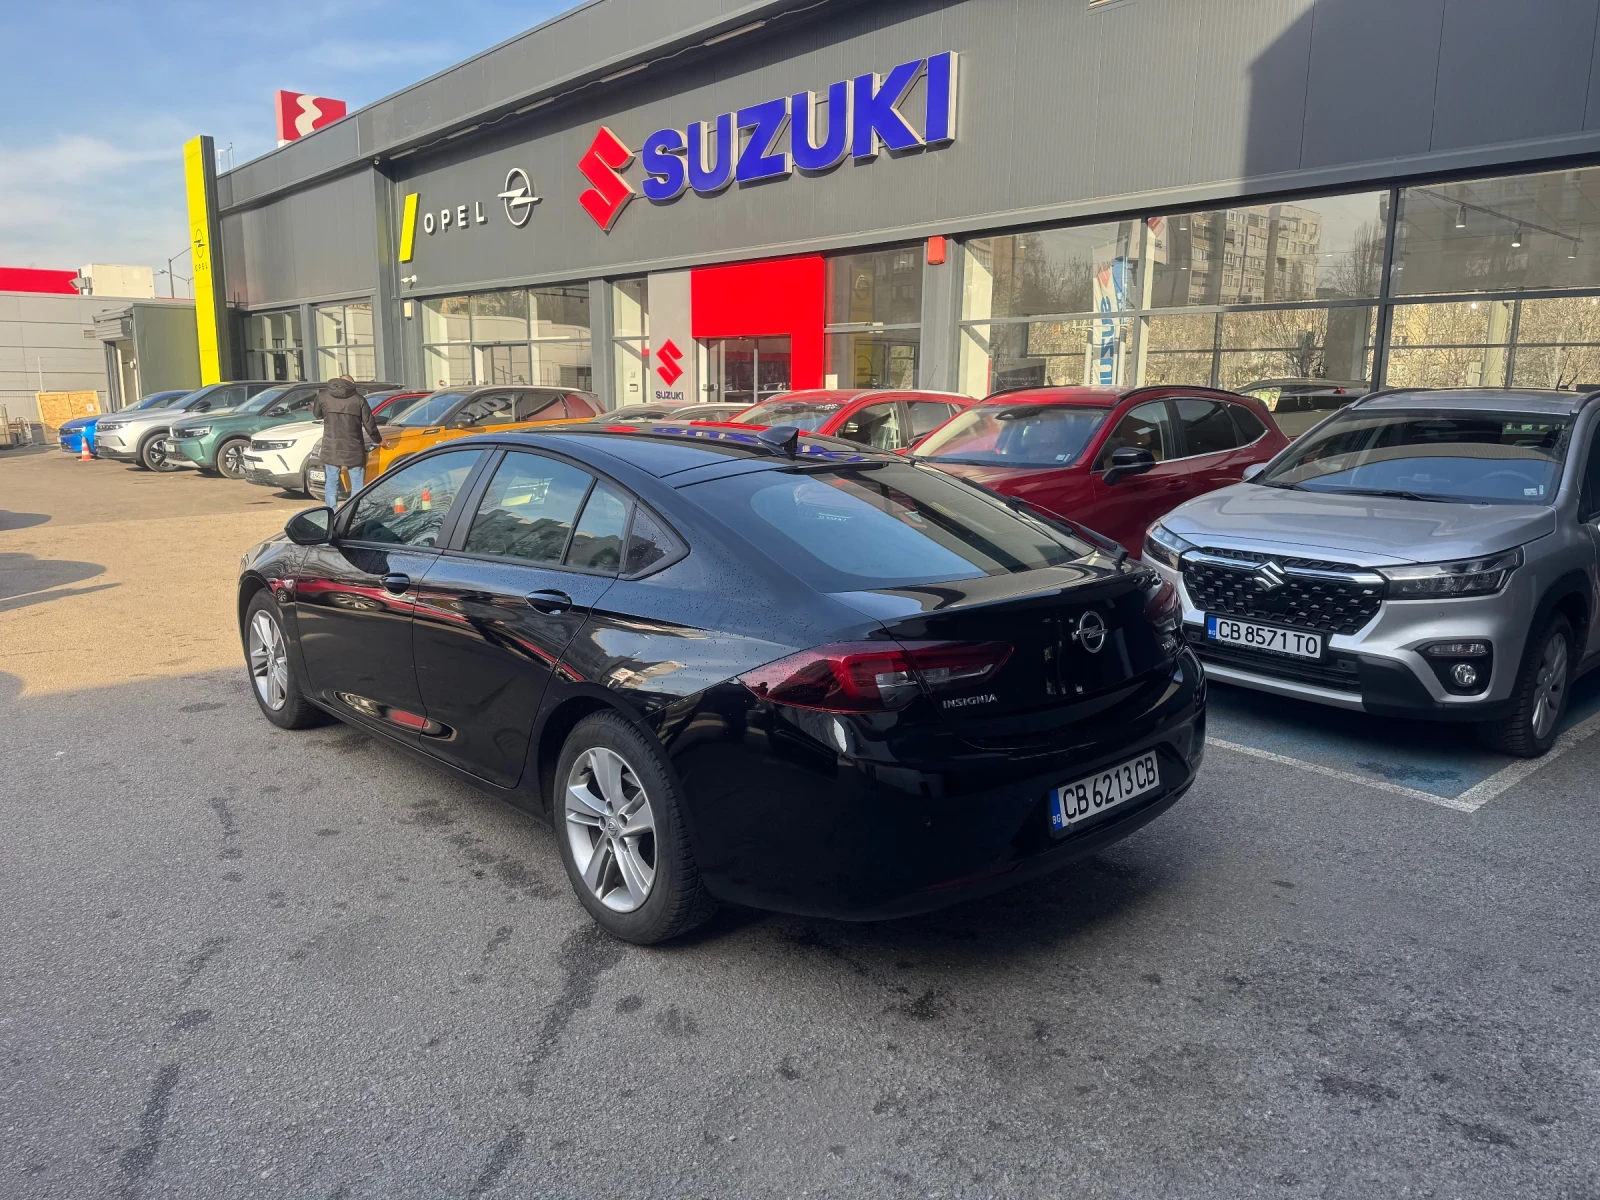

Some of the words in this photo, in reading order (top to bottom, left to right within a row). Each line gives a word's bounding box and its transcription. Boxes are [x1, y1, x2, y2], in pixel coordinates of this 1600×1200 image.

[642, 51, 958, 200] SUZUKI
[424, 201, 486, 235] OPEL
[194, 262, 208, 272] OPEL
[655, 390, 685, 400] SUZUKI
[1219, 621, 1241, 641] CB
[1244, 626, 1287, 650] 8571
[942, 693, 998, 709] INSIGNIA
[1052, 813, 1061, 825] BG
[1063, 783, 1089, 820] CB
[1092, 765, 1134, 808] 6213
[1134, 756, 1156, 789] CB
